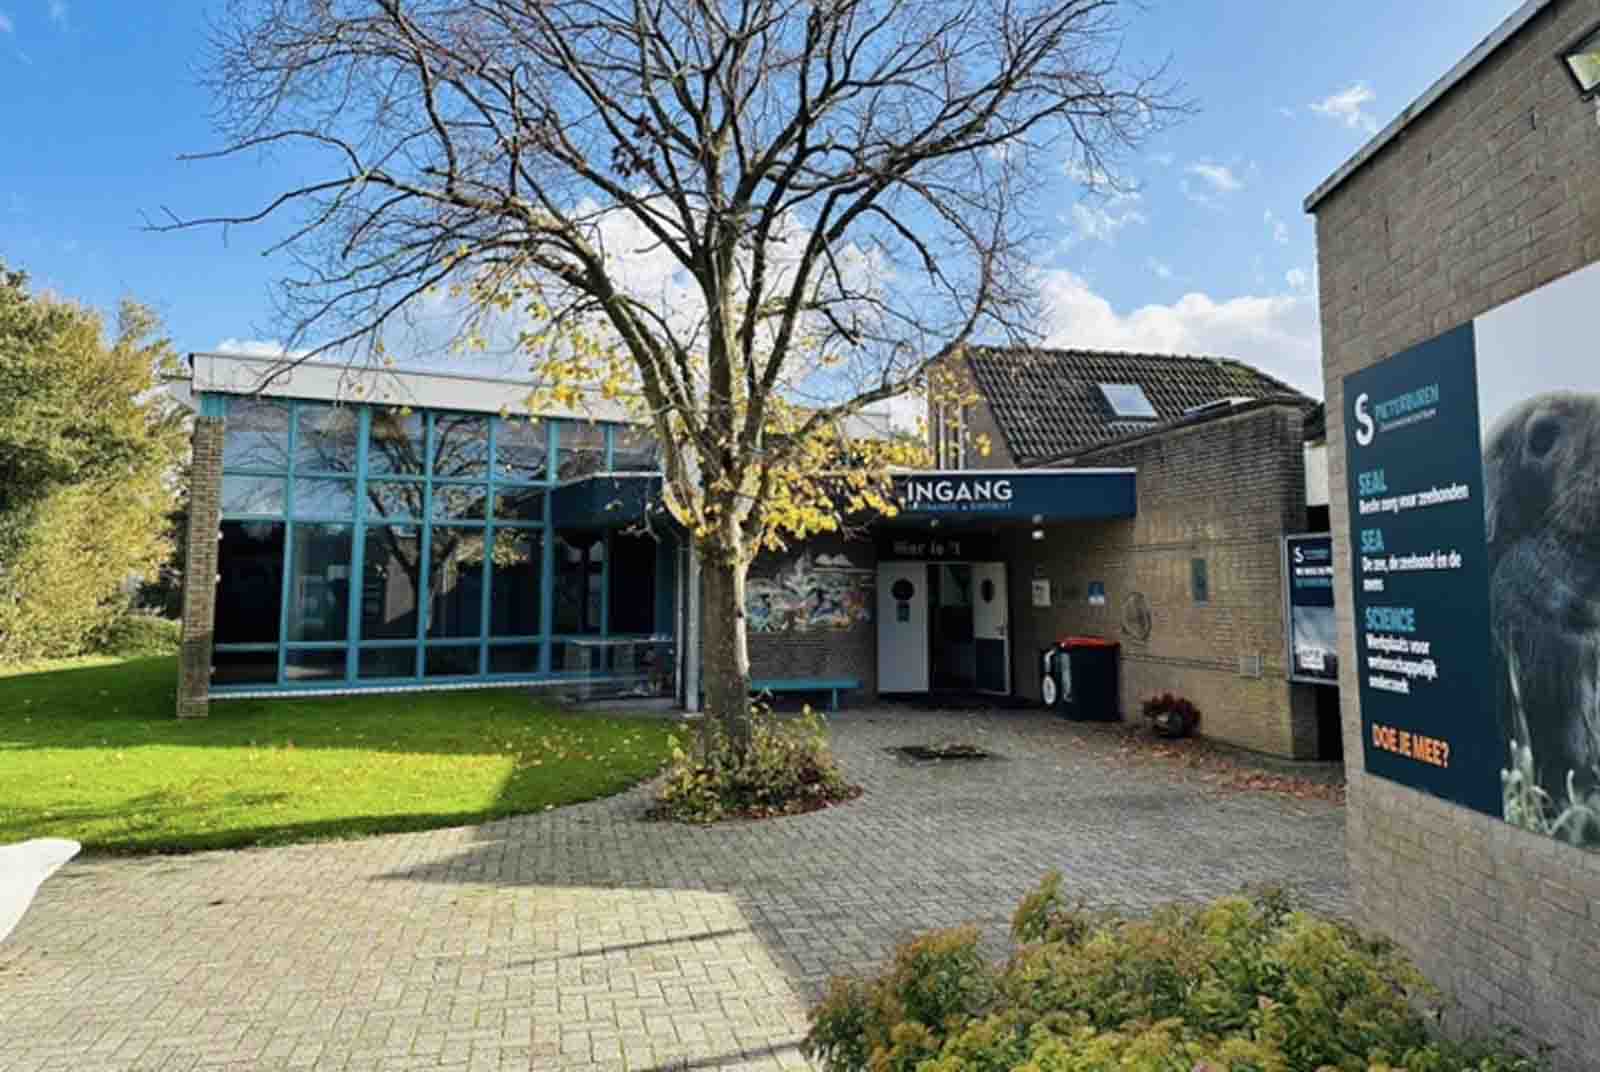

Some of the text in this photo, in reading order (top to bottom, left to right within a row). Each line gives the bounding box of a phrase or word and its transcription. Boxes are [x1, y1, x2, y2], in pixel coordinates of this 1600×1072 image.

[1355, 393, 1374, 446] S
[907, 480, 1013, 502] INGANG
[1359, 469, 1387, 495] SEAL
[1361, 528, 1385, 552] SEA
[1449, 547, 1462, 569] de
[1366, 607, 1416, 633] SCIENCE
[1371, 722, 1450, 768] DOE JE MEE?
